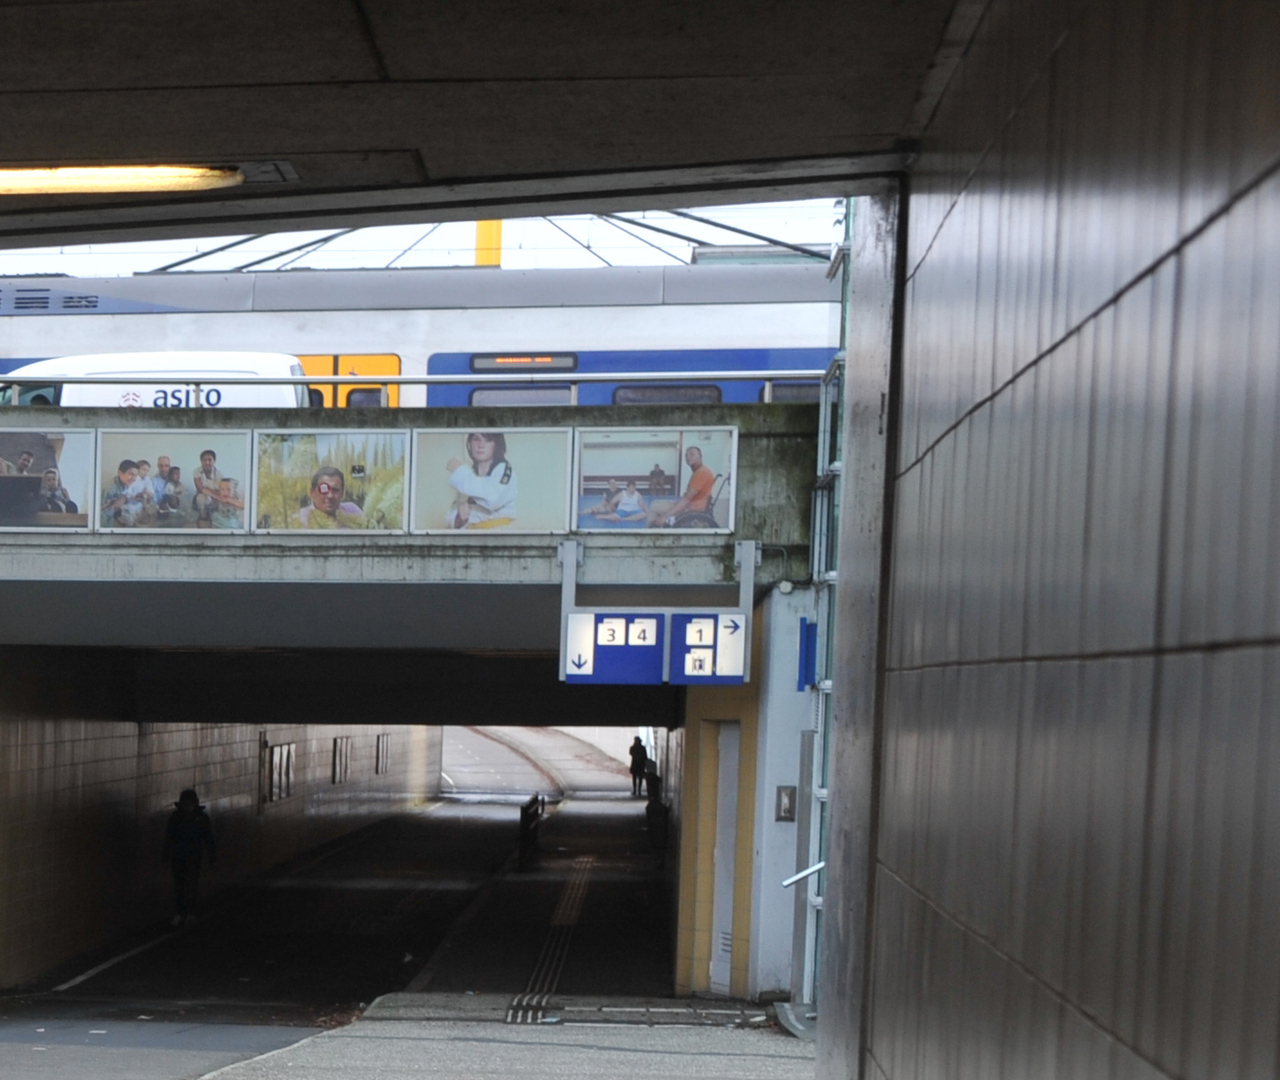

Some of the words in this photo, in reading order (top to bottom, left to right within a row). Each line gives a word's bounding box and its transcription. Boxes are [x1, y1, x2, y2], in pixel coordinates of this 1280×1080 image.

[606, 628, 616, 642] 3
[637, 628, 647, 642] 4
[696, 628, 703, 642] 1
